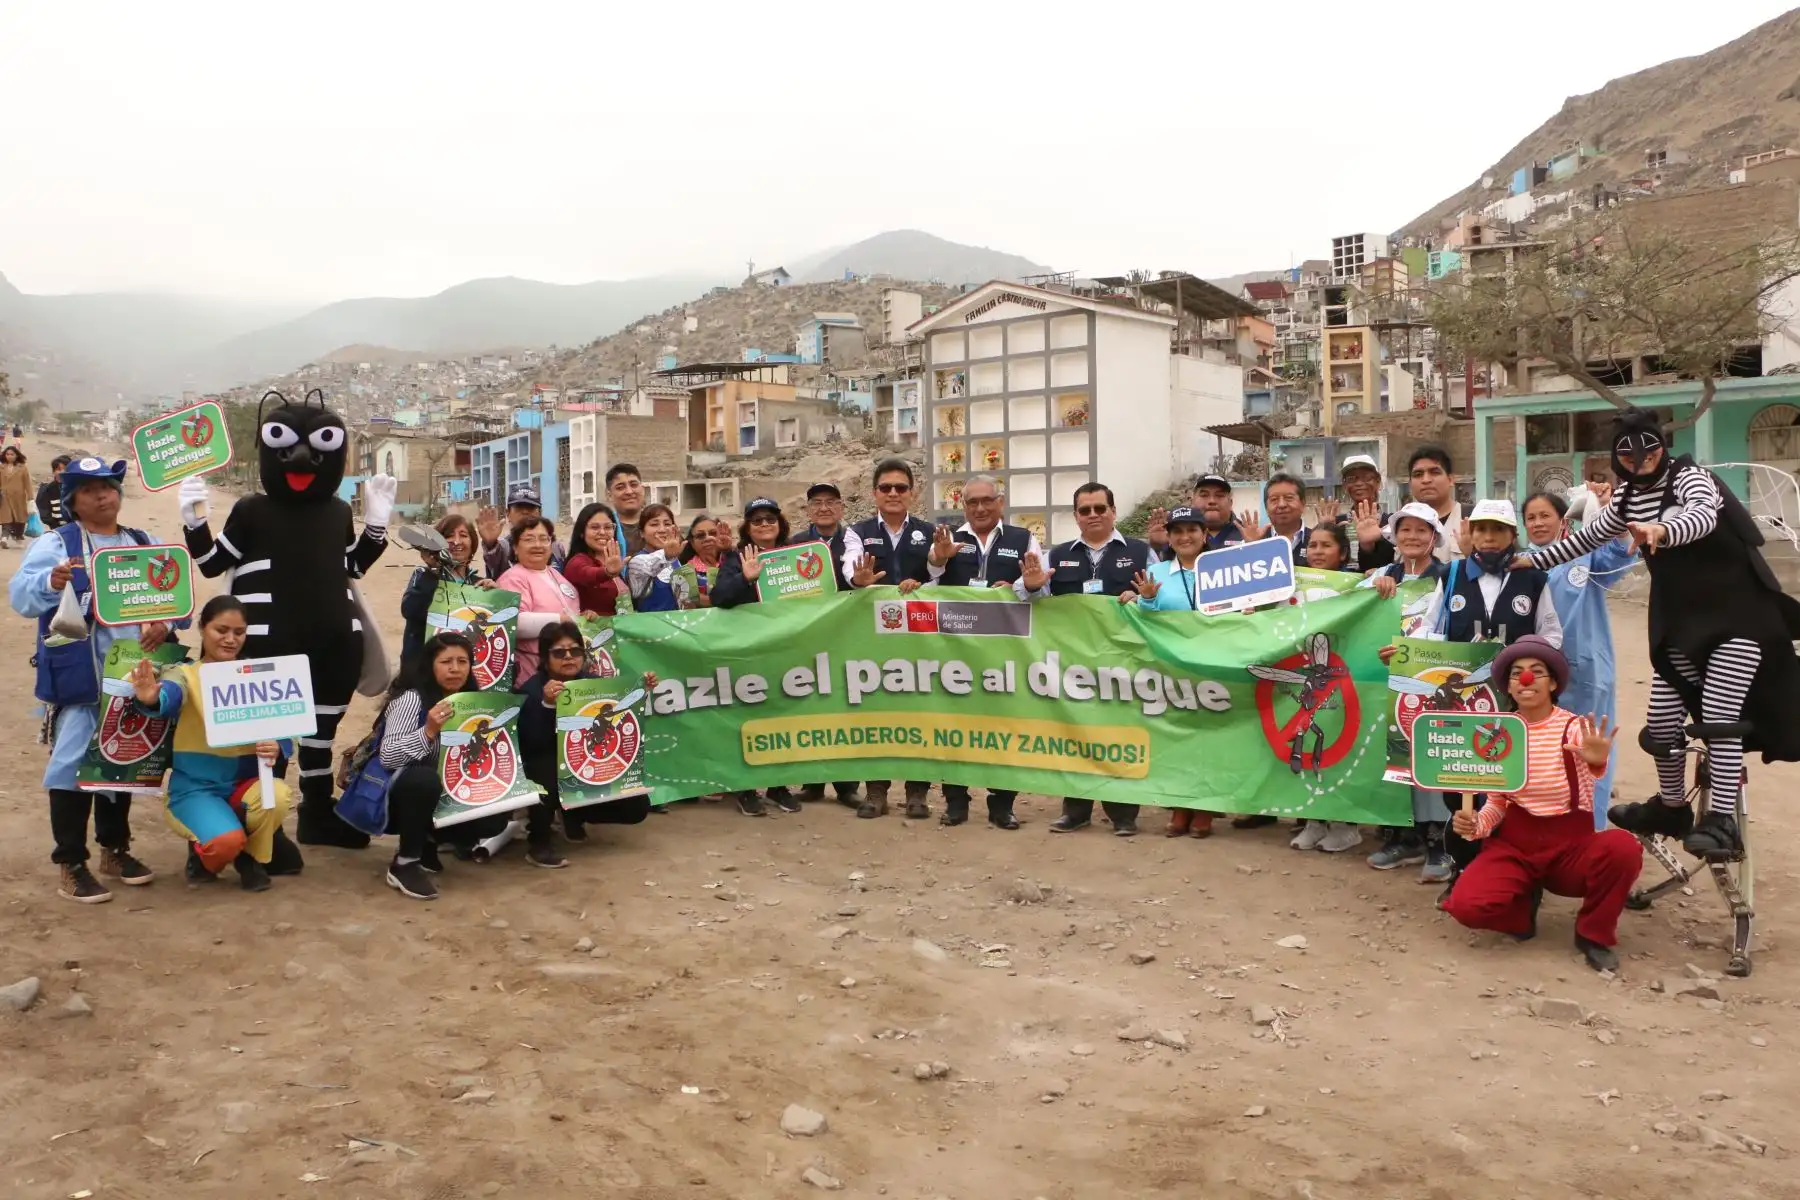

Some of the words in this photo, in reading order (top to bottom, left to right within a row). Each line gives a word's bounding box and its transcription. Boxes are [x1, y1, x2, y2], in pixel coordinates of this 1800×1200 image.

[965, 299, 997, 323] FAMILIA
[997, 293, 1021, 304] CASTRO
[1021, 297, 1047, 310] GARCIA
[146, 434, 177, 450] Hazle
[149, 451, 160, 462] el
[161, 443, 186, 459] pare
[171, 446, 212, 467] dengue
[108, 567, 141, 579] Hazle
[766, 564, 791, 576] Hazle
[1200, 556, 1288, 591] MINSA
[108, 581, 119, 593] el
[122, 582, 149, 594] pare
[768, 576, 776, 585] el
[778, 574, 799, 585] pare
[786, 580, 820, 593] dengue
[131, 592, 174, 605] dengue
[910, 611, 934, 621] PERÚ
[942, 613, 978, 621] Ministerio
[110, 645, 120, 665] 3
[1397, 644, 1410, 664] 3
[1414, 647, 1442, 659] Pasos
[782, 651, 832, 698] el
[845, 657, 973, 704] pare
[982, 660, 1016, 693] al
[1027, 650, 1232, 715] dengue
[211, 677, 303, 708] MINSA
[562, 688, 572, 706] 3
[216, 710, 249, 722] DIRIS
[250, 707, 278, 718] LIMA
[280, 702, 303, 715] SUR
[747, 732, 792, 752] ¡SIN
[796, 727, 928, 749] CRIADEROS,
[933, 728, 964, 748] NO
[969, 730, 1012, 750] HAY
[1018, 734, 1146, 763] ZANCUDOS!
[1428, 732, 1465, 744] Hazle
[1427, 747, 1439, 757] el
[1442, 748, 1474, 759] pare
[1442, 763, 1451, 771] al
[1452, 762, 1503, 775] dengue
